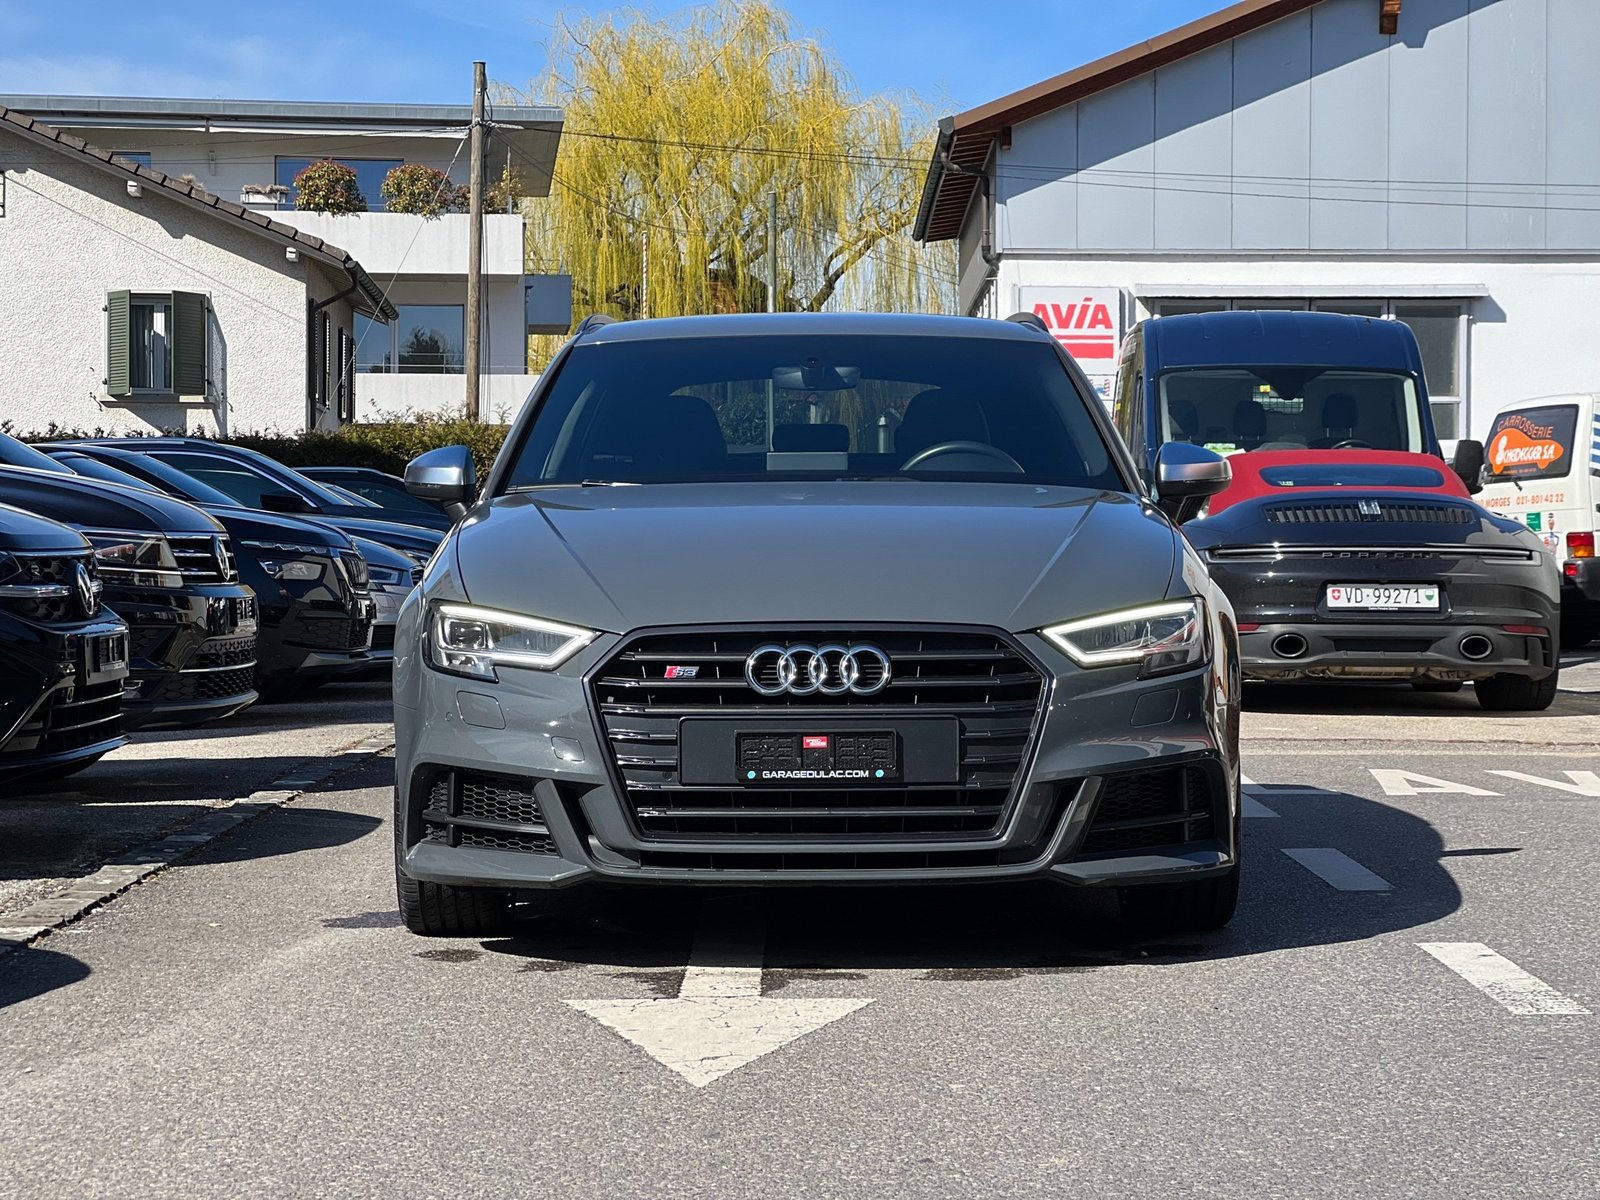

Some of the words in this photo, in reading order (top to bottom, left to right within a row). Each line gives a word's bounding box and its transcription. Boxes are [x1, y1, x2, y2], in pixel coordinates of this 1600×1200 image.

[1497, 415, 1554, 438] CARROSSERIE
[1485, 497, 1511, 508] MORGES
[1321, 551, 1441, 559] PORSCHE
[670, 666, 697, 678] S3
[762, 770, 869, 779] GARAGEDULAC.COM
